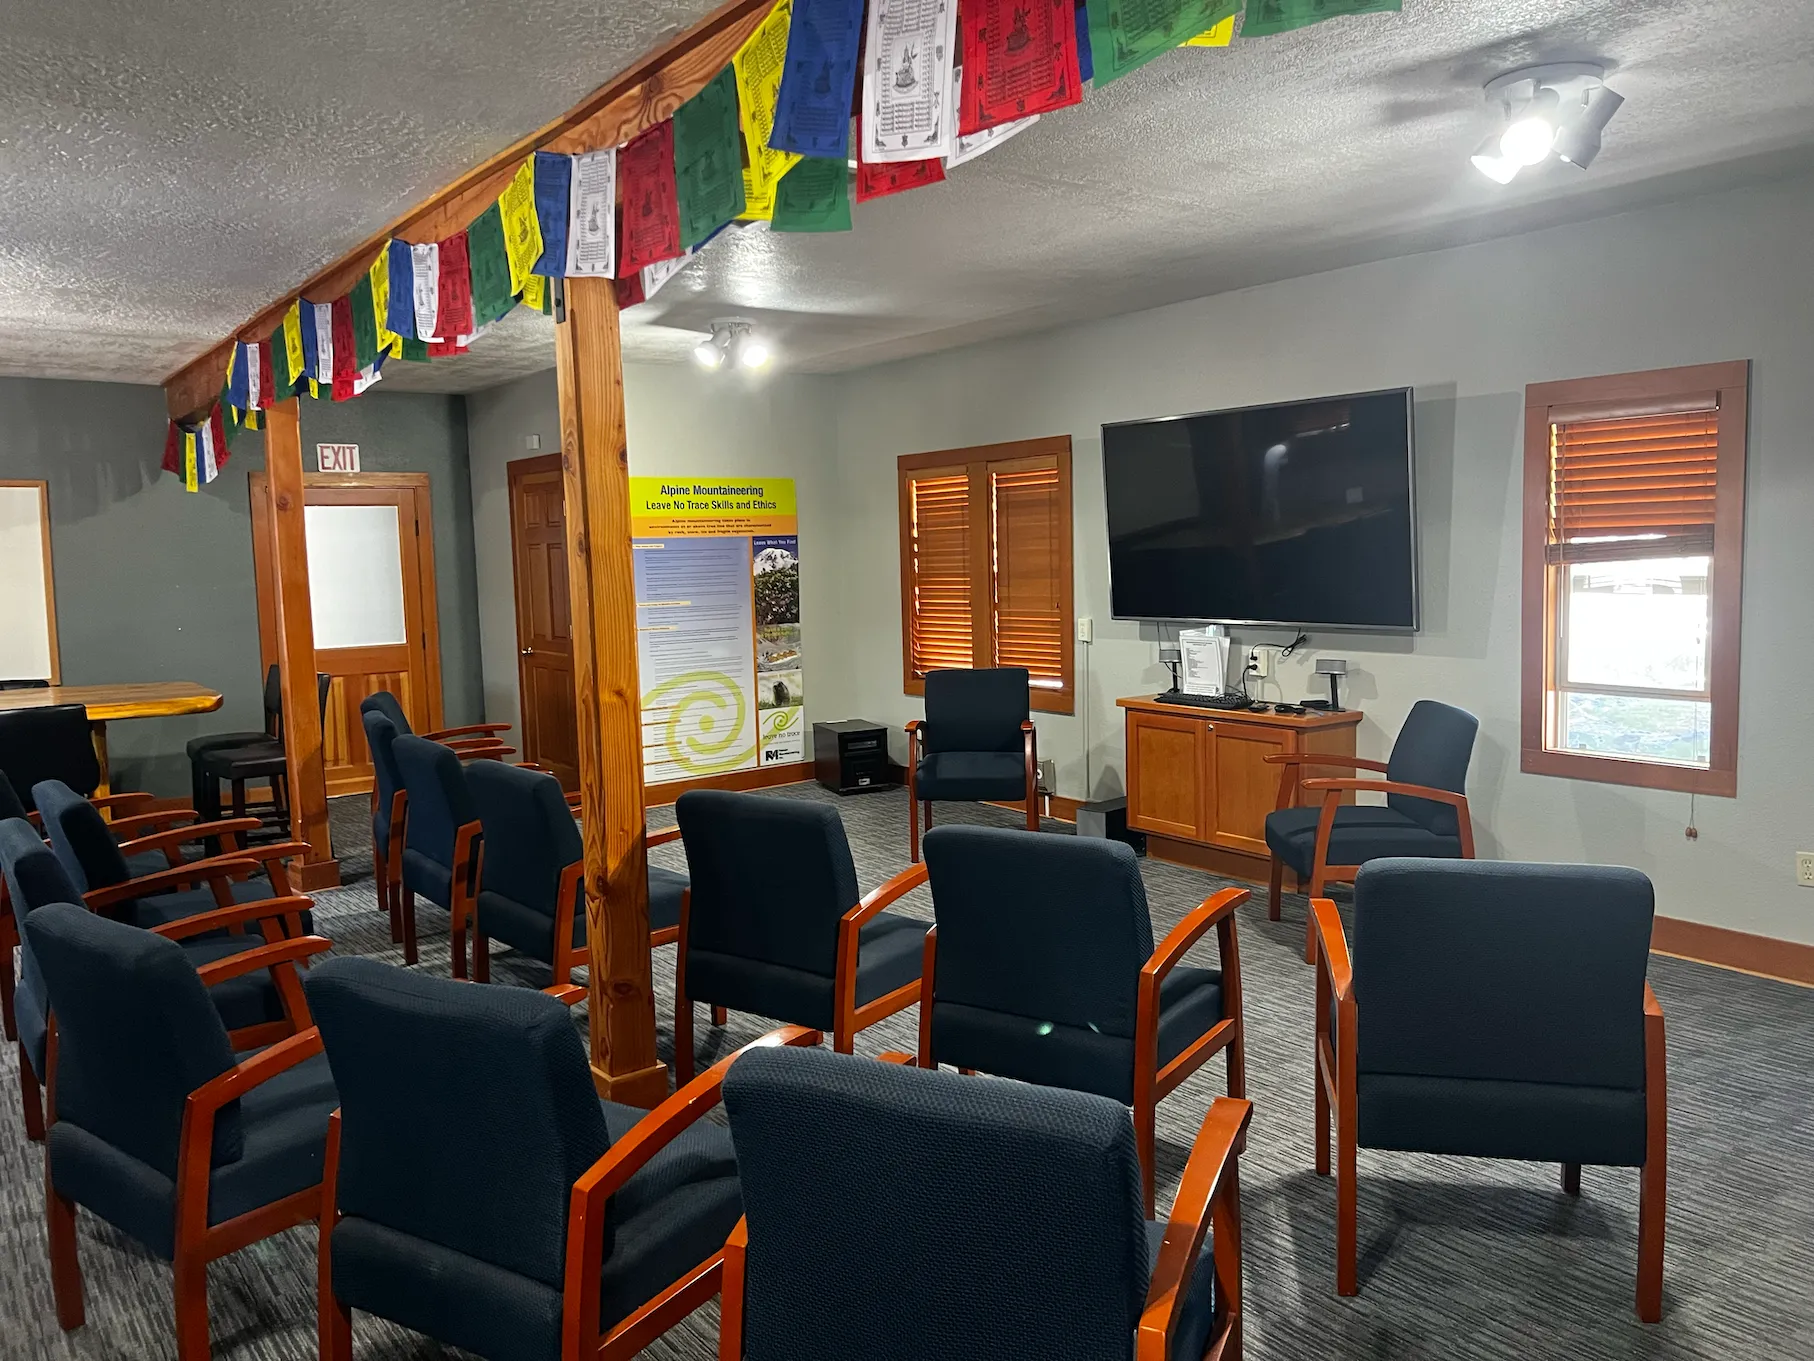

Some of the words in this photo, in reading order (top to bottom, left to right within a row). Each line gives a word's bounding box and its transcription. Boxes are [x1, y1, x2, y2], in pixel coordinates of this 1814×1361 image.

[319, 446, 357, 470] EXIT
[660, 485, 690, 497] Alpine
[693, 484, 764, 497] Mountaineering
[646, 501, 671, 510] Leave
[674, 501, 685, 510] No
[687, 501, 709, 510] Trace
[711, 500, 734, 510] Skills
[736, 500, 751, 510] and
[753, 500, 777, 510] Ethics
